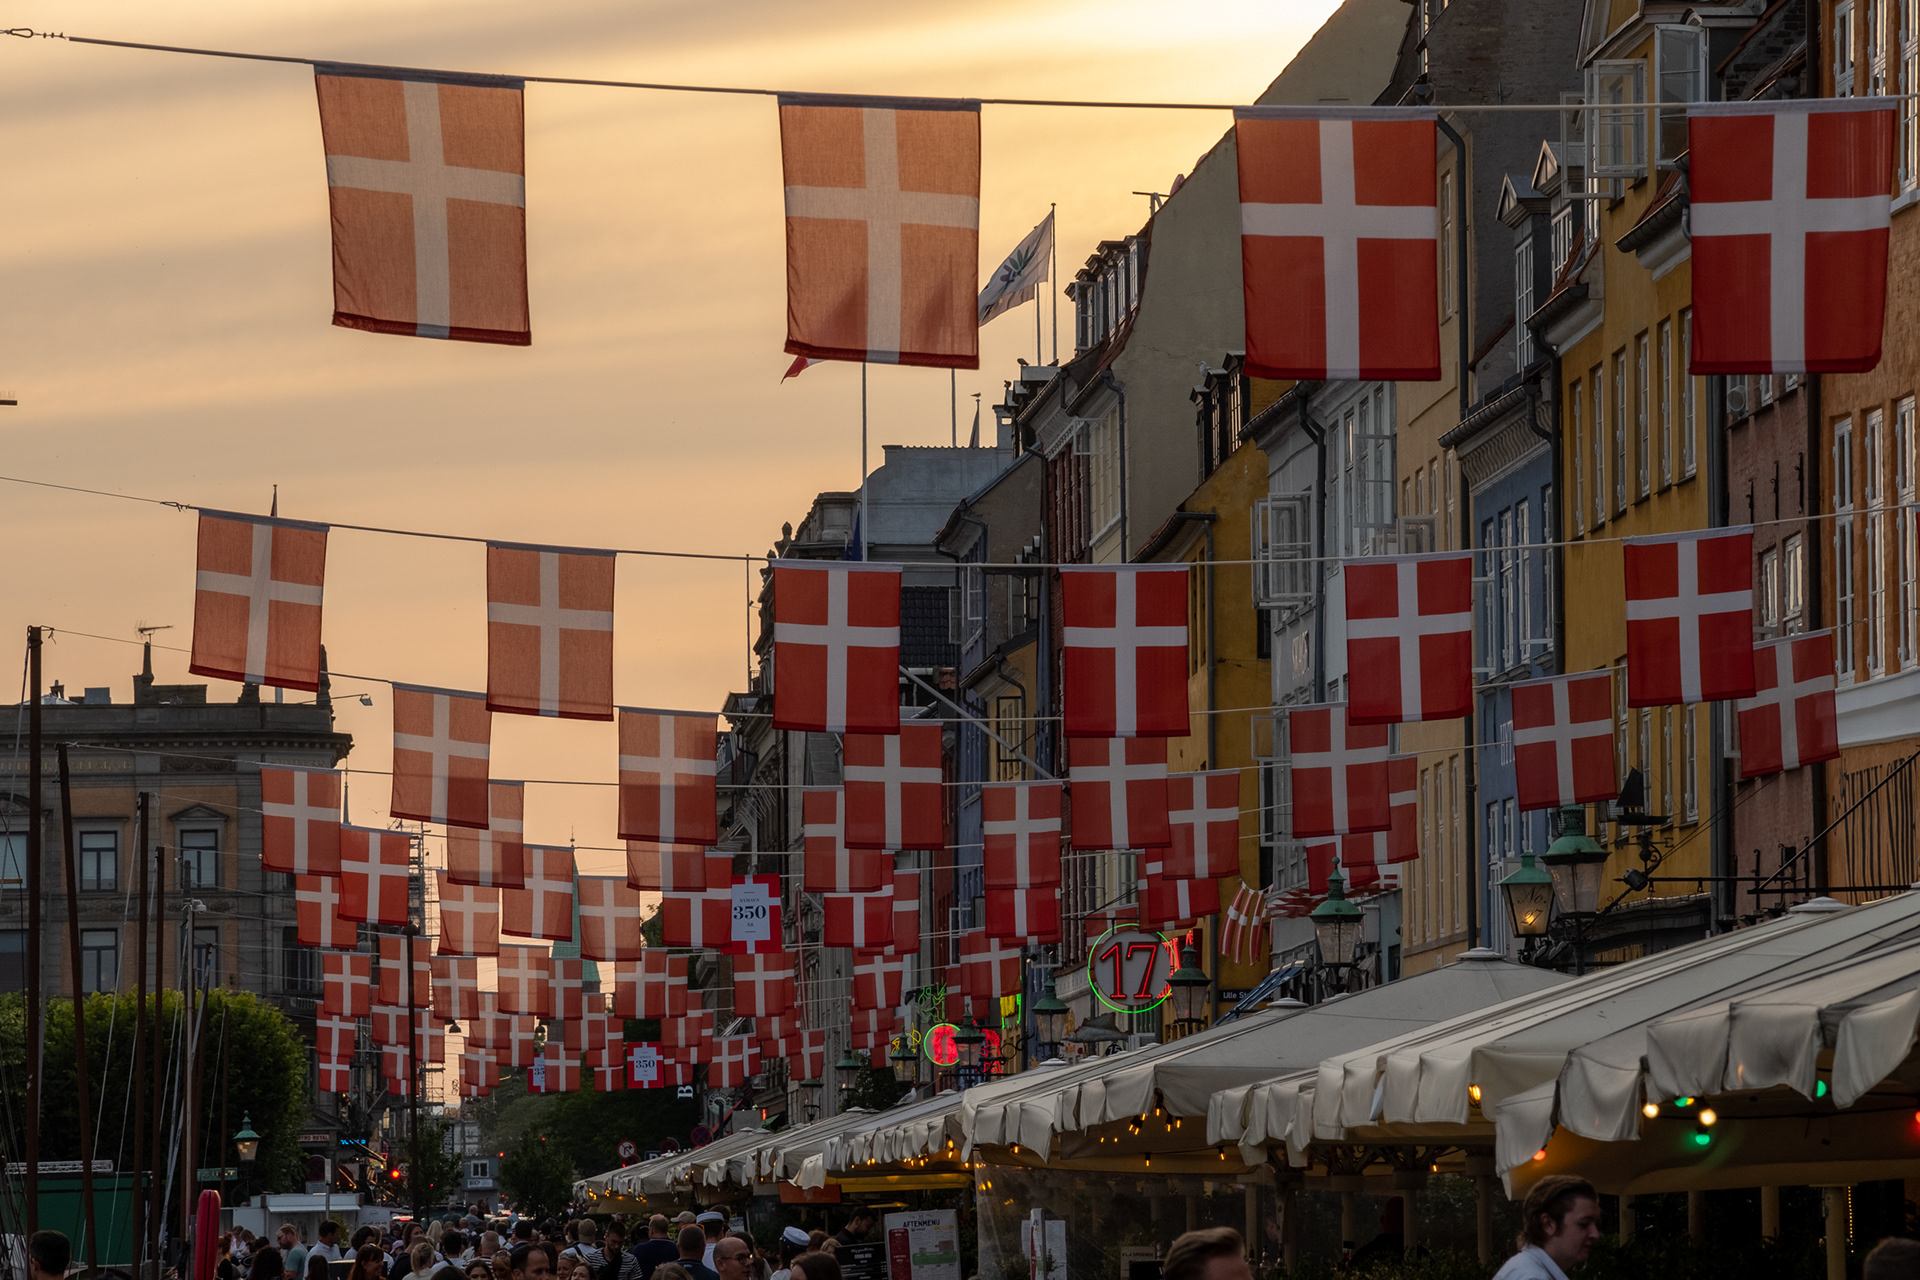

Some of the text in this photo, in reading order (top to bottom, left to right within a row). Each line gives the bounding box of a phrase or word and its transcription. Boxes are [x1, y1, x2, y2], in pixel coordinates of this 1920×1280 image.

[1516, 885, 1547, 904] No.
[733, 905, 767, 920] 350
[1100, 942, 1159, 999] 17
[635, 1059, 655, 1069] 350
[534, 1067, 546, 1076] 35
[903, 1219, 941, 1228] AFTENMENU
